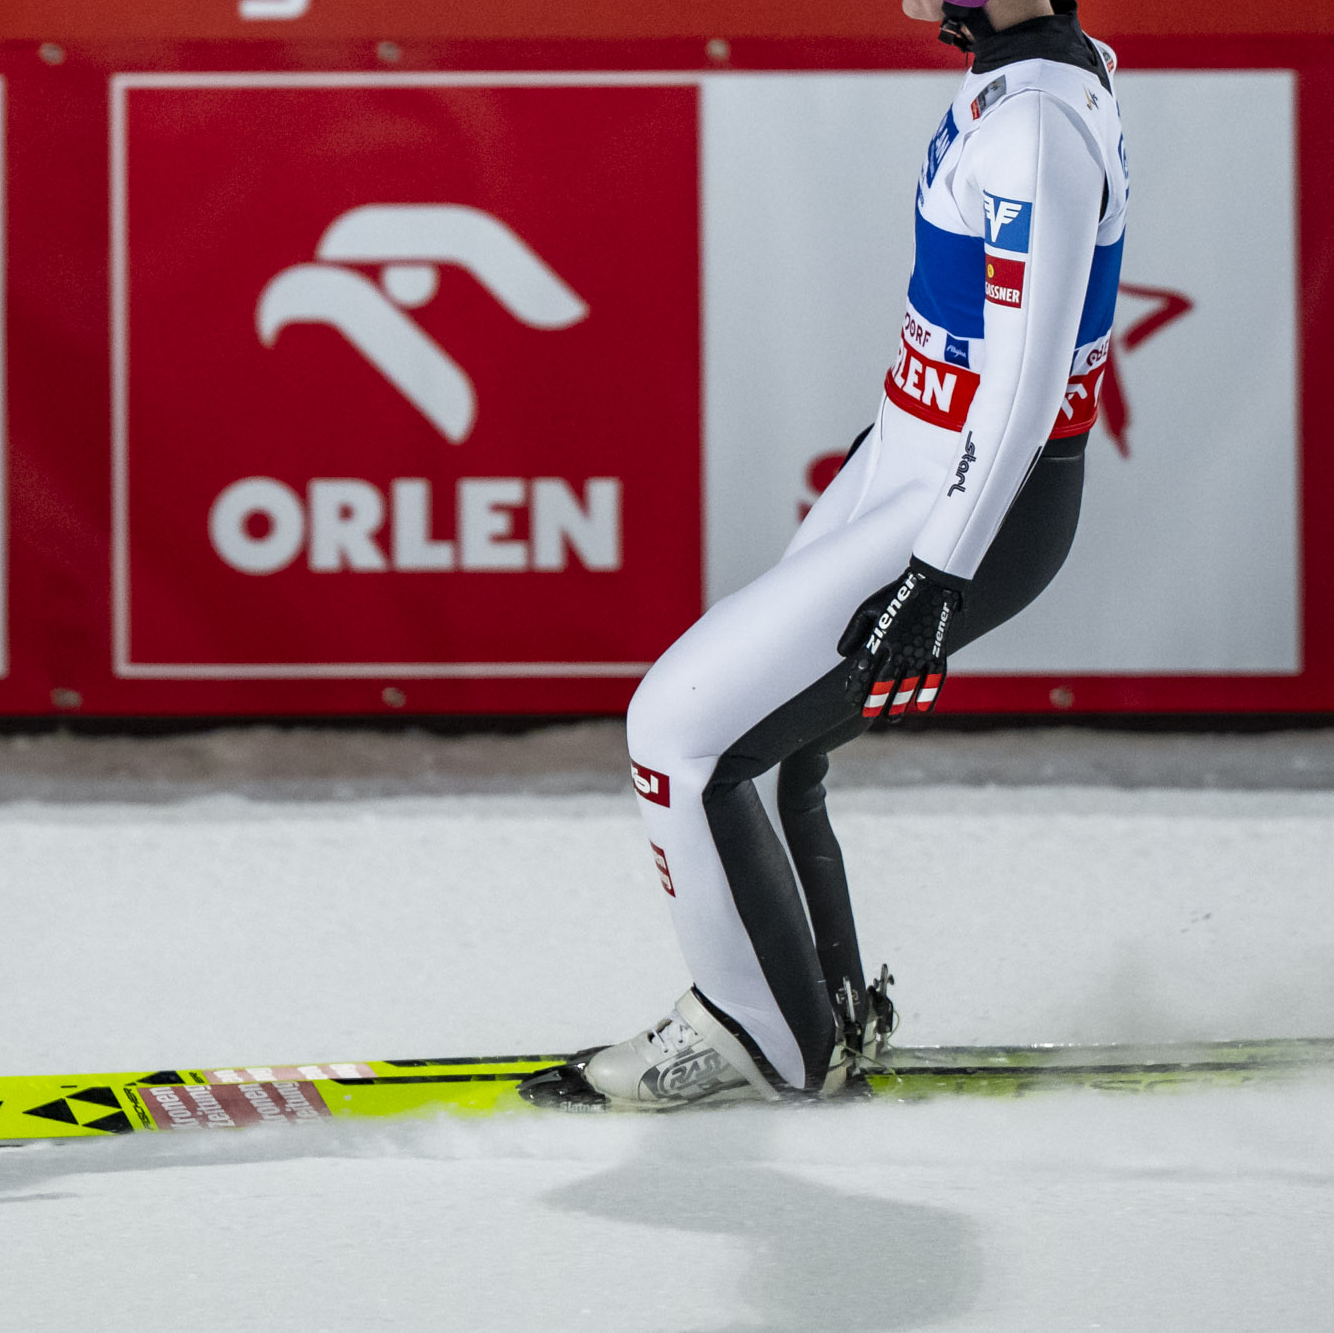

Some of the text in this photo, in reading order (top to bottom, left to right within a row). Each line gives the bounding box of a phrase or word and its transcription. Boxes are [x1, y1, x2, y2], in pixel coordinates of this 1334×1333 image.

[890, 344, 957, 414] RLEN
[208, 476, 623, 575] ORLEN
[866, 572, 917, 656] ziener
[931, 601, 952, 659] ziener
[182, 1084, 236, 1129] Zeitung
